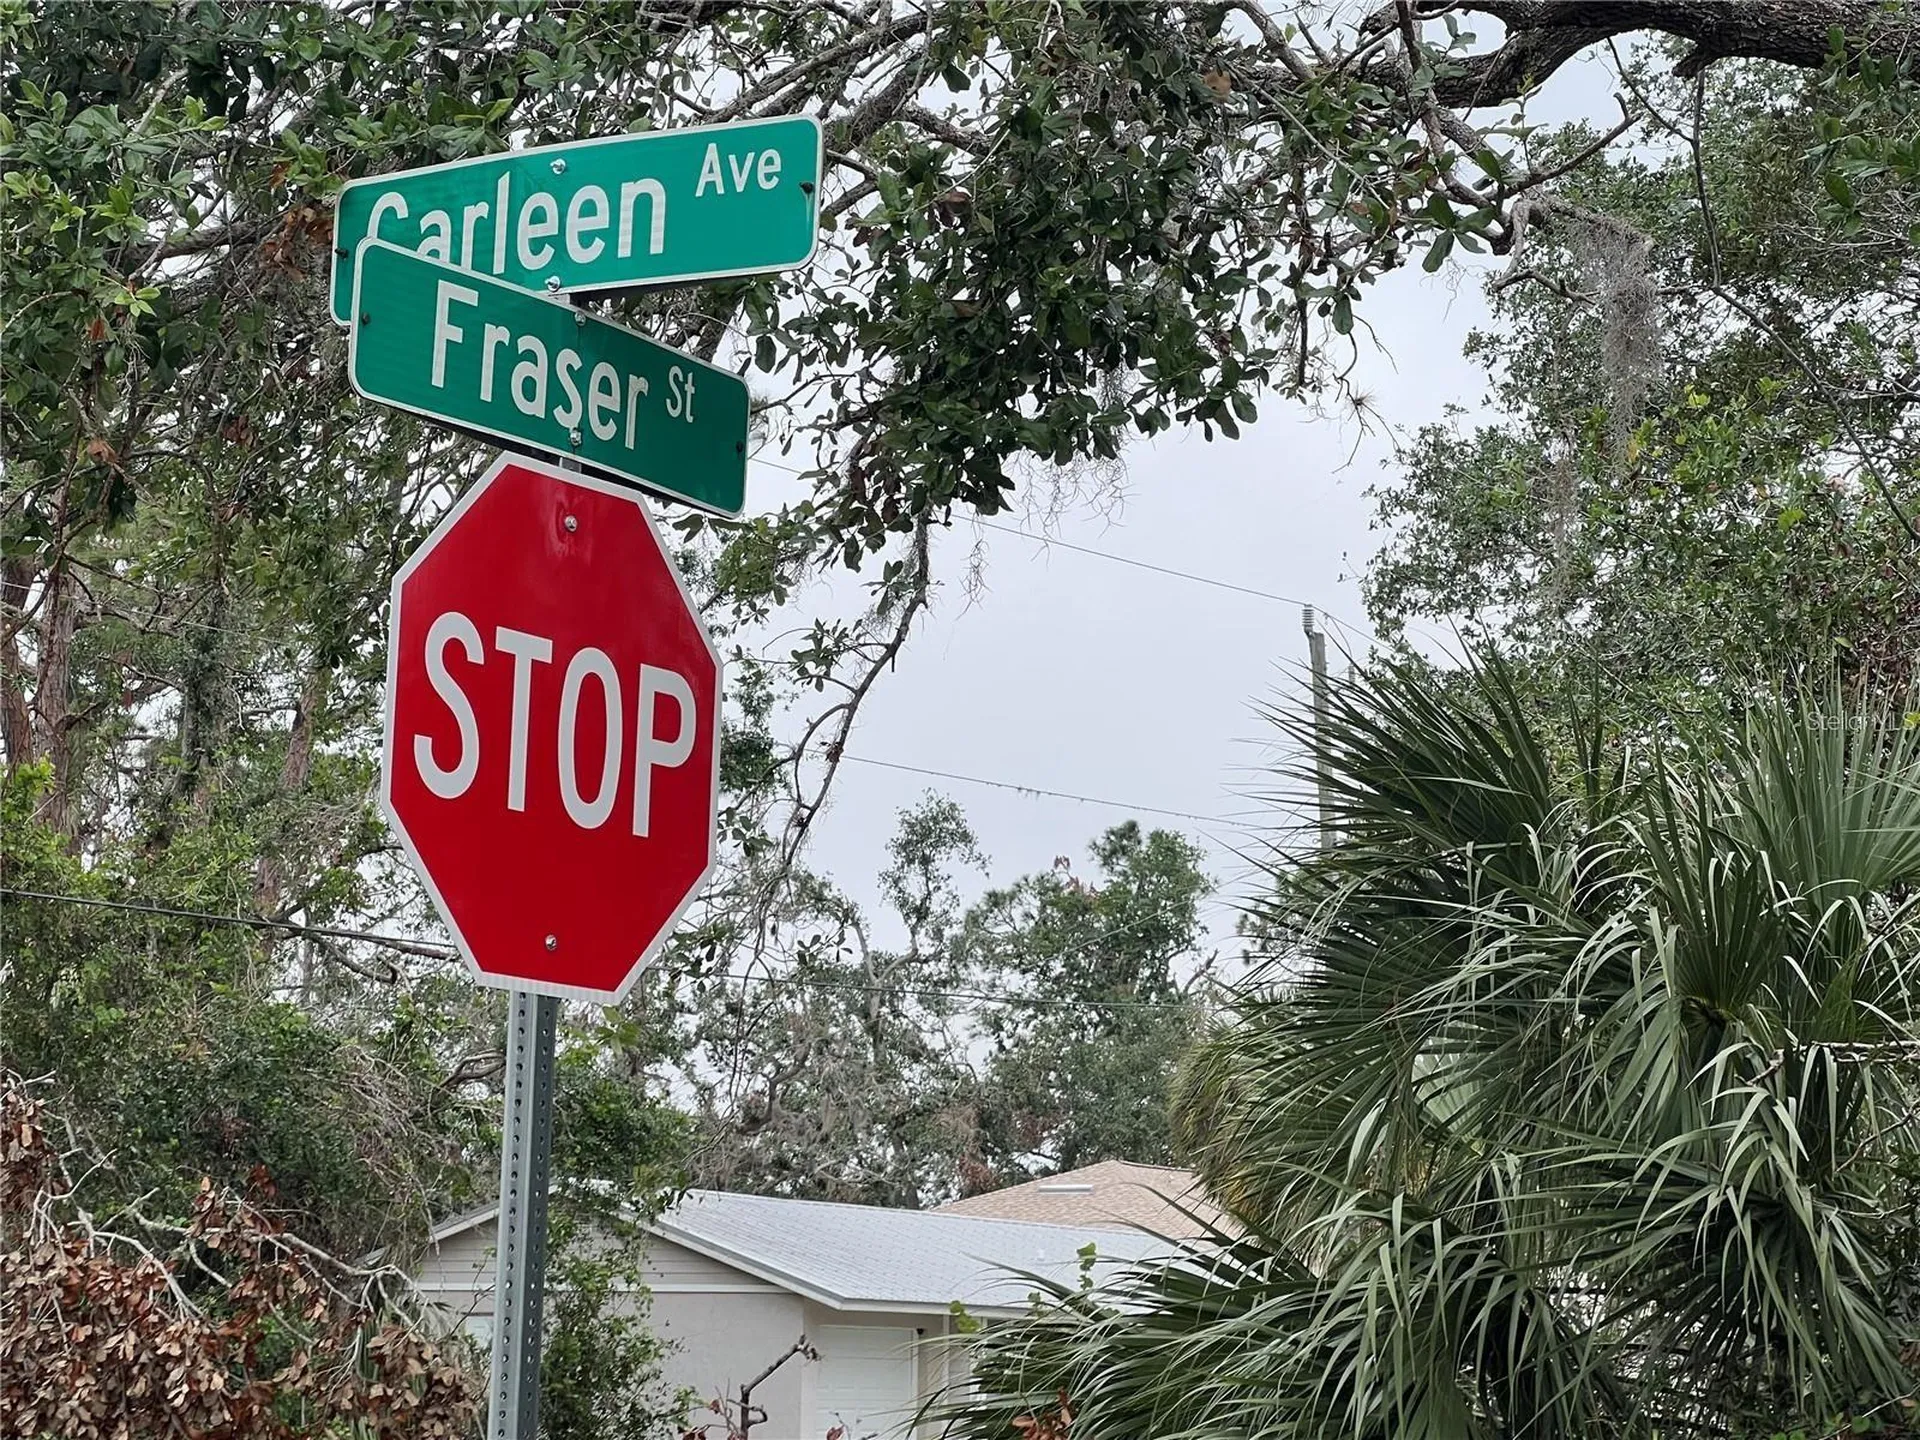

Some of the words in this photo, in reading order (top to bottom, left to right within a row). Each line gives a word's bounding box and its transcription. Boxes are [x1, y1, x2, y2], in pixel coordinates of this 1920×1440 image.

[696, 143, 782, 197] Ave
[431, 279, 649, 449] Fraser
[665, 364, 695, 422] St
[413, 611, 697, 838] STOP
